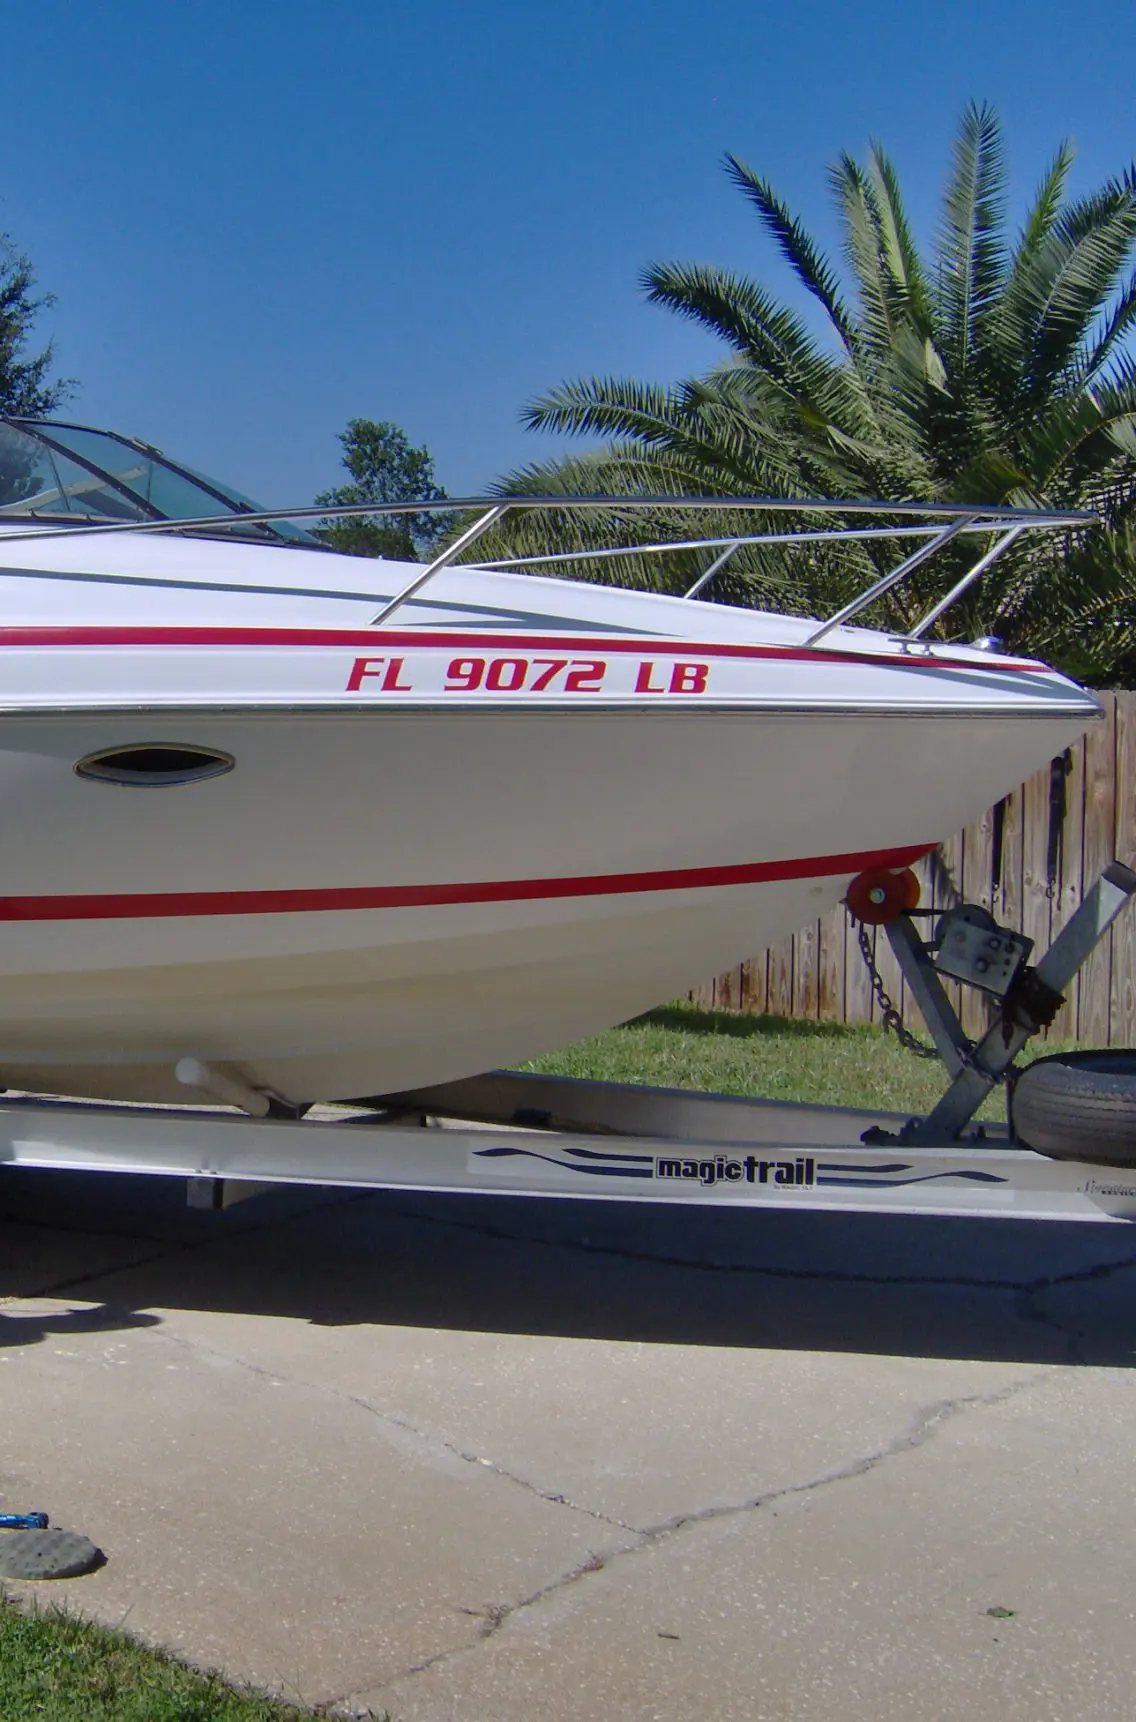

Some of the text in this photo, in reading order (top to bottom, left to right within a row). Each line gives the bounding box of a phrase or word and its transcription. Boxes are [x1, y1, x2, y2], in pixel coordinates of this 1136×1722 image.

[345, 657, 710, 694] FL 9072 LB
[656, 1155, 814, 1186] magictrail
